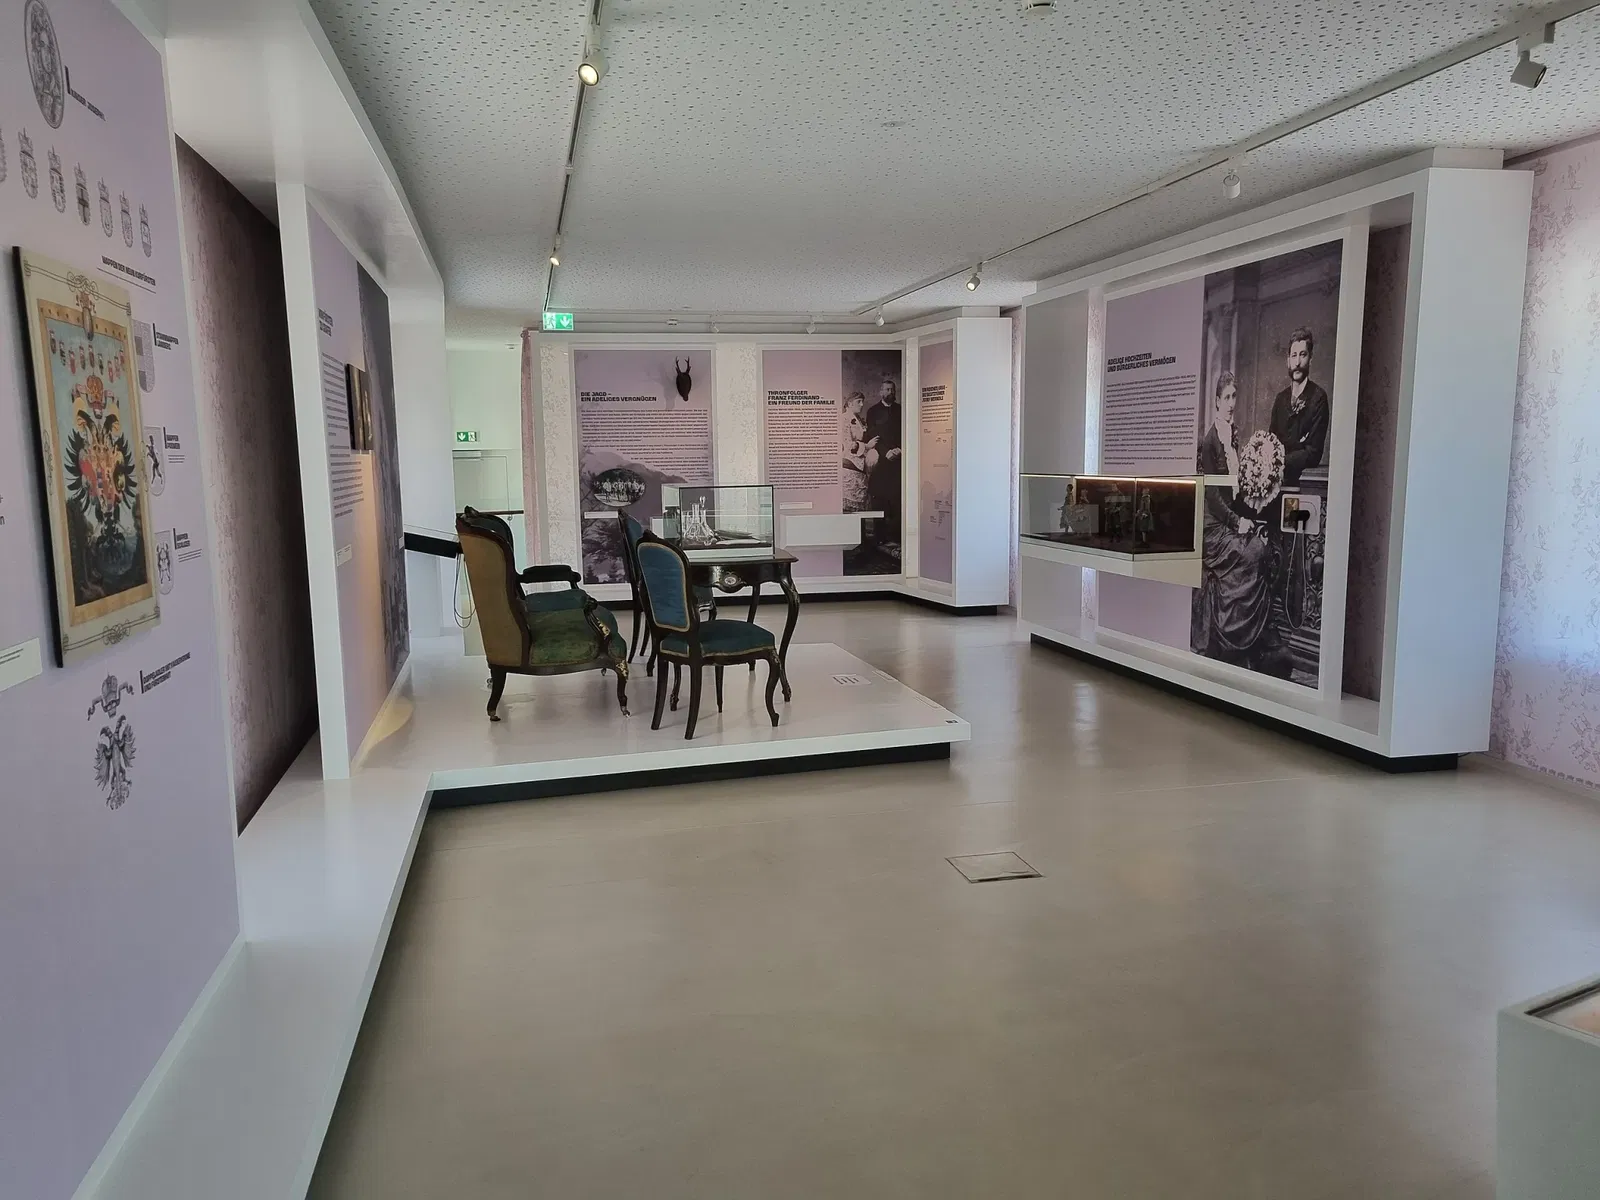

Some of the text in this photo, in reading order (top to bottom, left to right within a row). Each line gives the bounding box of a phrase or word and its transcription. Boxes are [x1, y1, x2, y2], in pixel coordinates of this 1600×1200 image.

[1108, 352, 1152, 365] ADELIGE HOCHZEITEN
[1116, 360, 1148, 372] BÜRGERLICHES
[1150, 356, 1176, 366] VERMÖGEN
